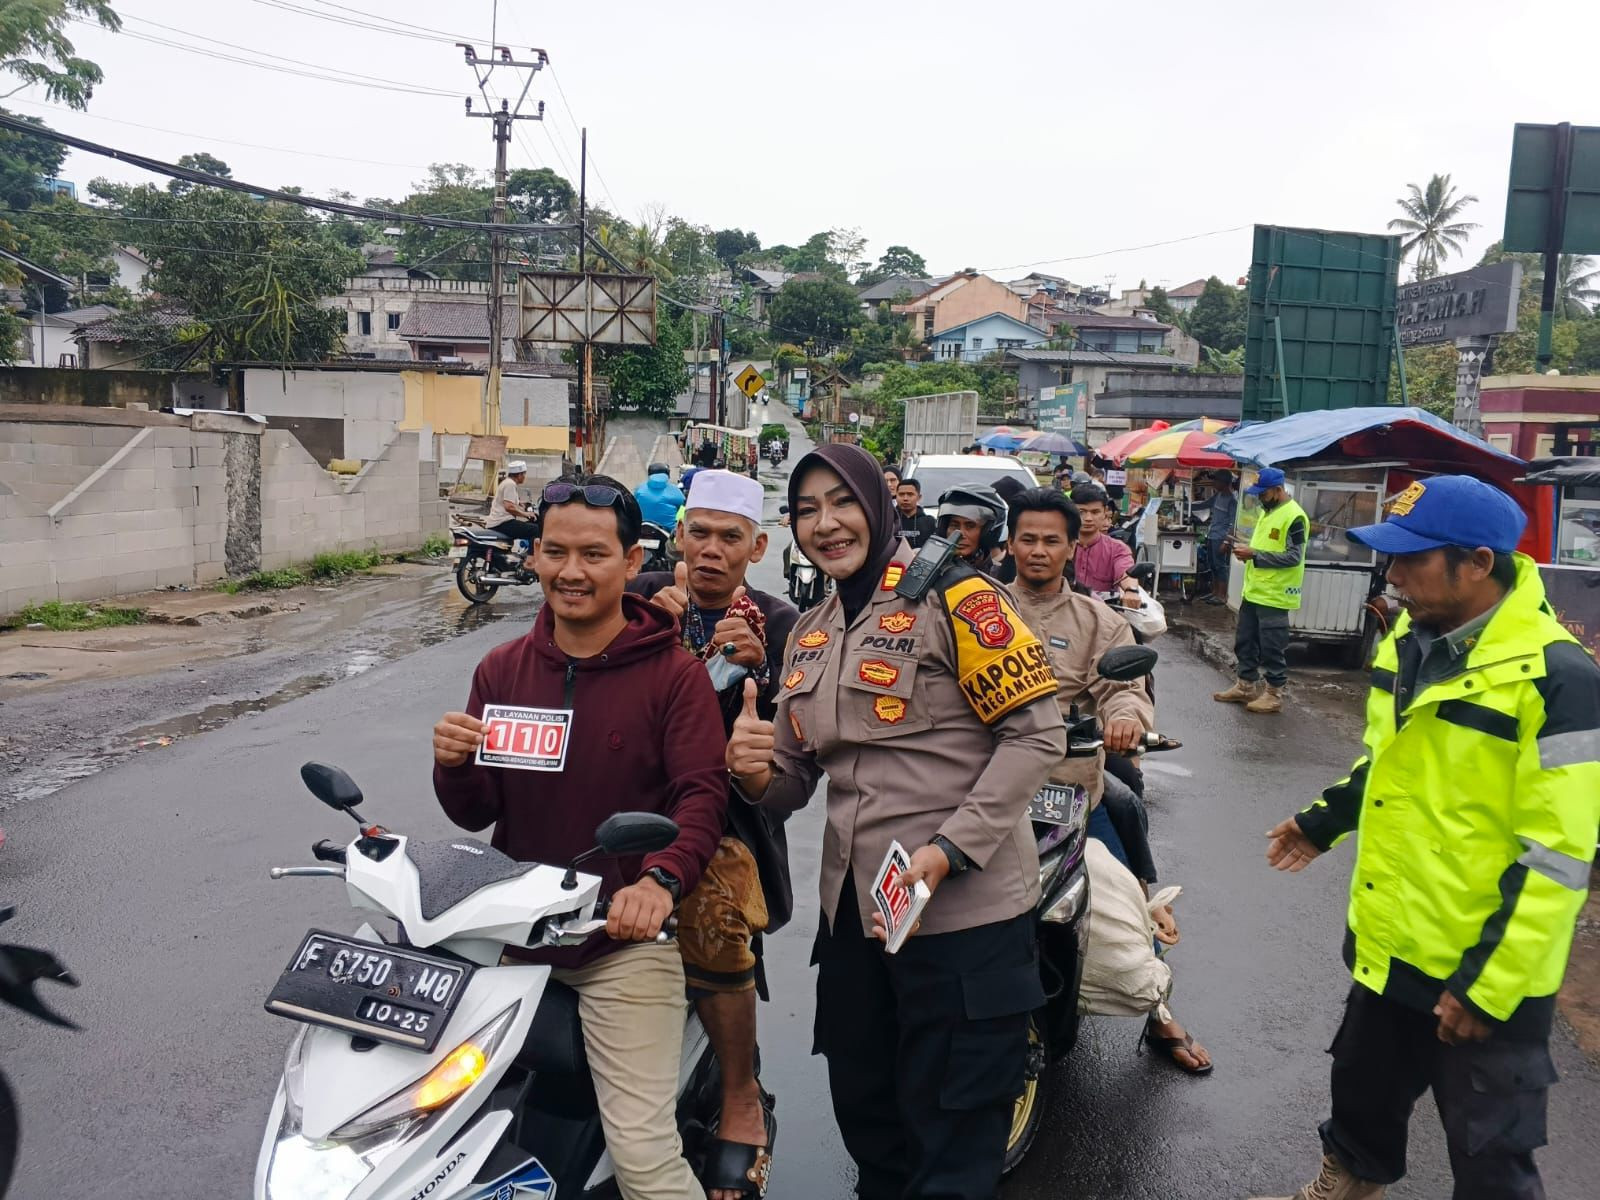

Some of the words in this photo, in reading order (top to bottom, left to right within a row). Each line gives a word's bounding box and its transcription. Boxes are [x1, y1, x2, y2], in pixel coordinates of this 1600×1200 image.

[860, 635, 915, 654] POLRI
[503, 711, 539, 722] LAYANAN
[540, 713, 565, 723] POLISI
[494, 724, 558, 753] 110
[299, 942, 325, 969] F
[329, 949, 393, 987] 6750
[411, 1151, 468, 1200] HONDA
